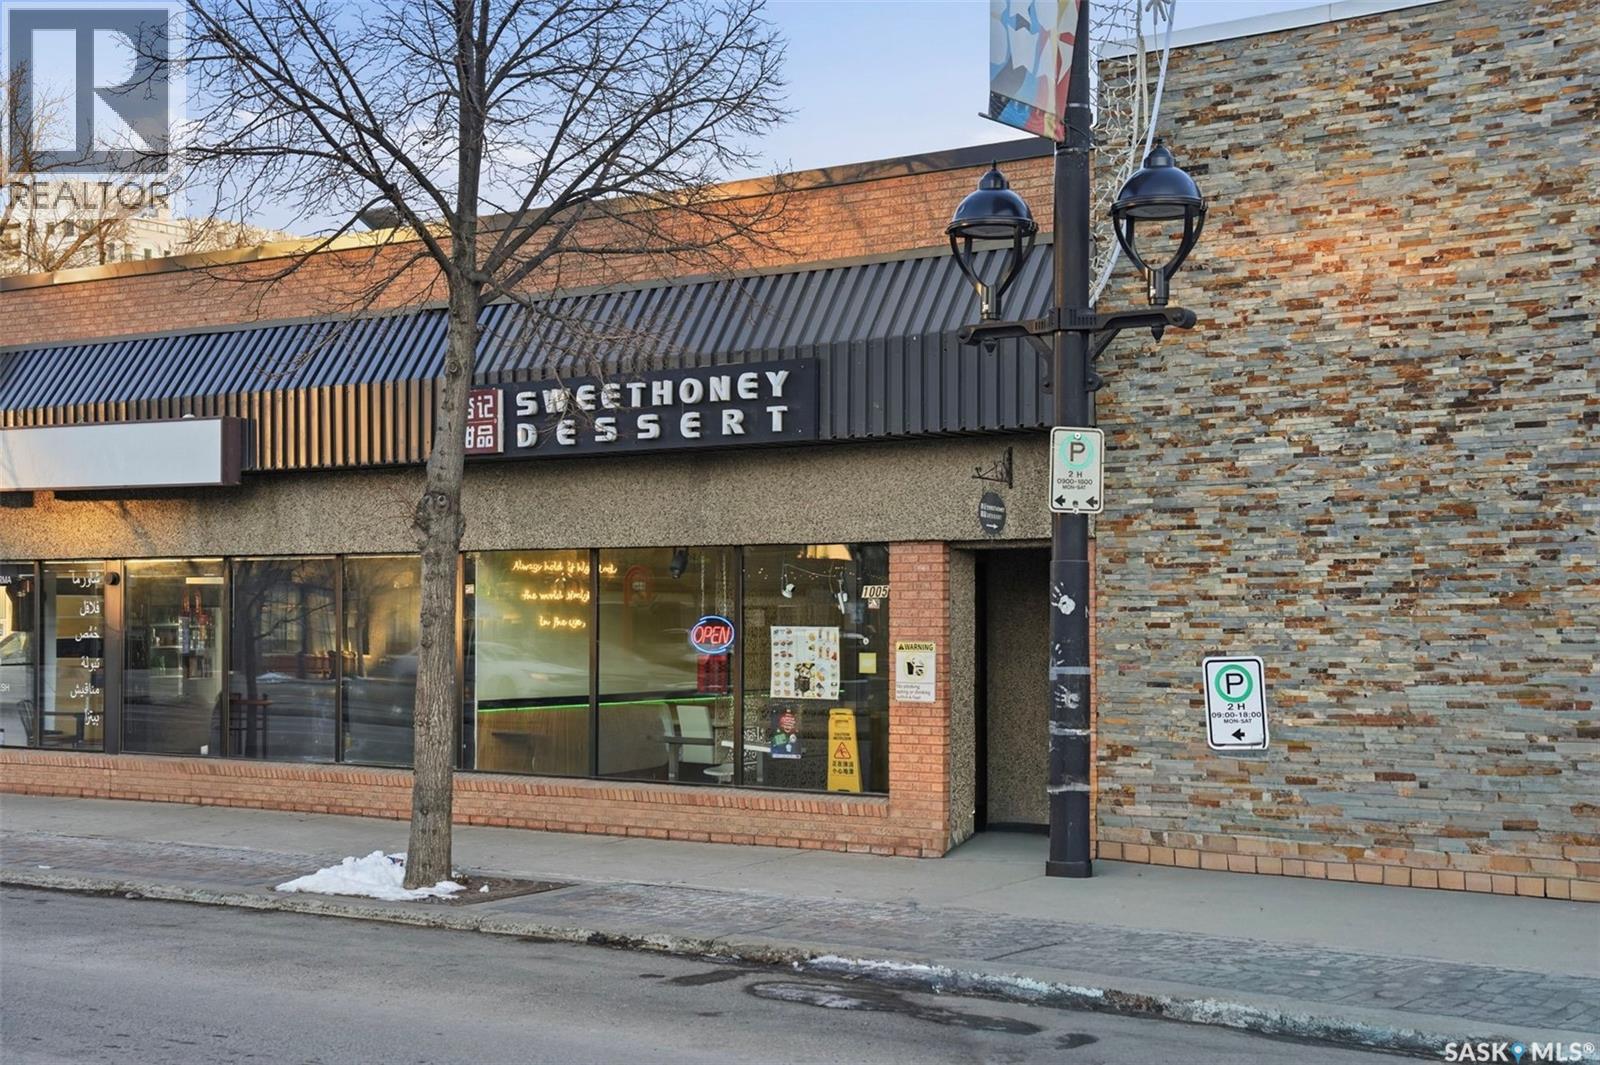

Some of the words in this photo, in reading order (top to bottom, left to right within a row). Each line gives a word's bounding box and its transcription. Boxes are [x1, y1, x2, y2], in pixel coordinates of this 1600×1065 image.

[515, 369, 790, 417] SWEETHONEY
[516, 405, 788, 448] DESSERT
[1070, 441, 1086, 462] P
[862, 585, 888, 598] 1005
[693, 625, 731, 645] OPEN
[903, 643, 934, 652] WARNING
[1225, 672, 1244, 695] P
[1211, 711, 1262, 719] 09:00-18:00
